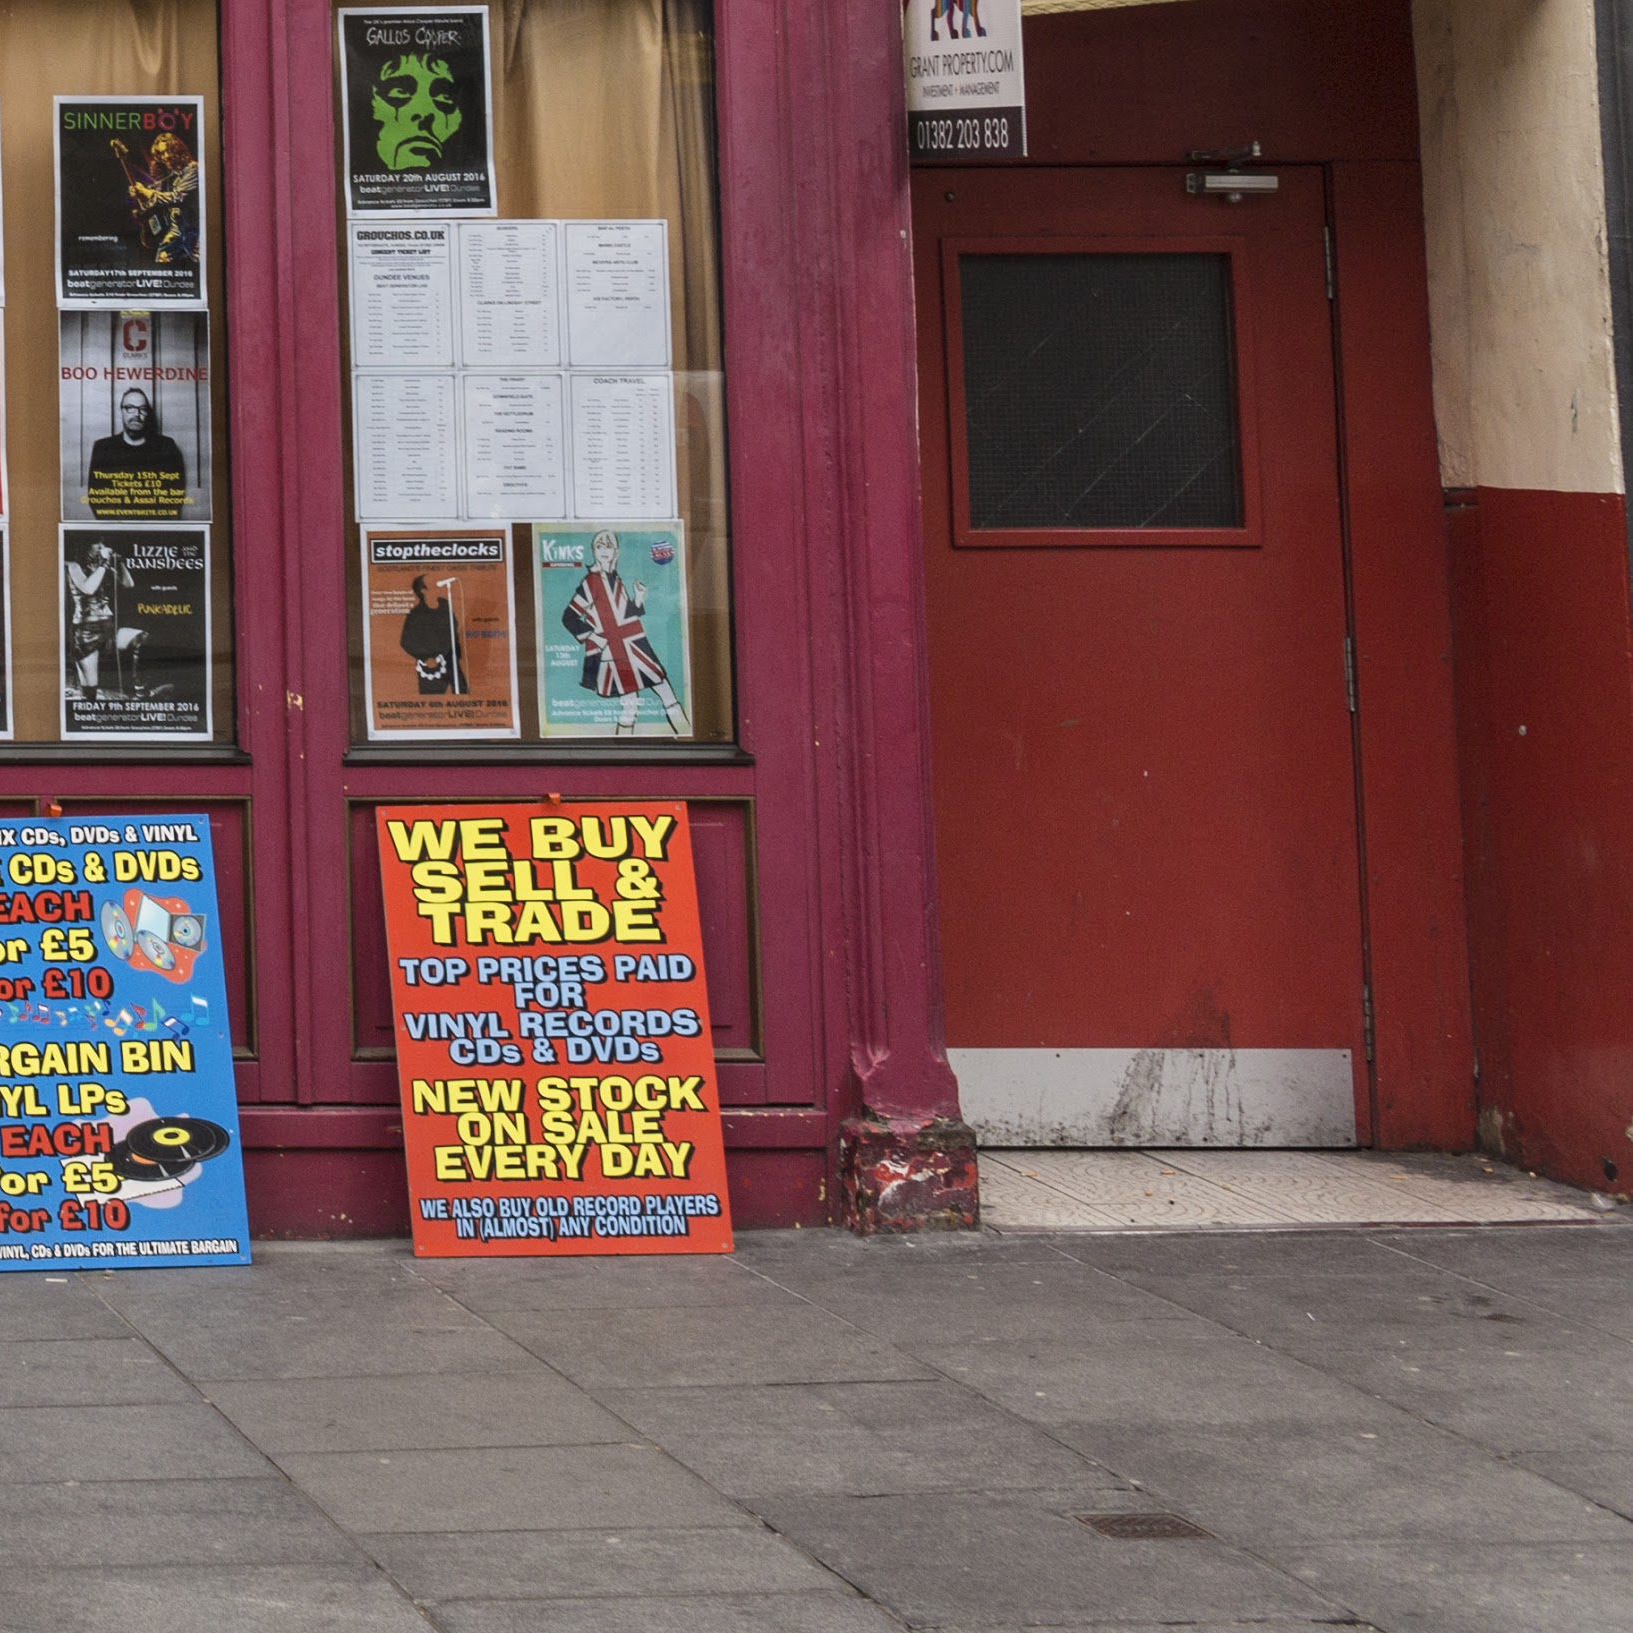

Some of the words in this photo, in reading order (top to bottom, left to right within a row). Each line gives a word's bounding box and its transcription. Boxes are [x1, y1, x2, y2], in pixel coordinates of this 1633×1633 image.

[366, 27, 411, 46] GALLUS
[910, 55, 939, 79] GRANT
[942, 50, 1014, 75] PROPERTY.COM
[64, 108, 193, 130] SINNERBOY
[917, 120, 953, 150] 01382
[957, 119, 979, 149] 203
[984, 118, 1009, 148] 838
[357, 230, 445, 241] GROUCHOS.CO.UK
[62, 367, 97, 380] BOO
[104, 367, 208, 381] HEWERDINE
[93, 471, 134, 480] Thursday
[136, 471, 157, 479] 15th
[159, 471, 180, 480] Sept
[375, 542, 499, 559] stoptheclocks
[386, 818, 508, 863] WE
[530, 815, 677, 861] BUY
[8, 853, 75, 886] CDs
[84, 851, 105, 883] &
[114, 851, 201, 883] DVDs
[412, 858, 596, 906] SELL
[615, 856, 663, 902] &
[418, 898, 667, 946] TRADE
